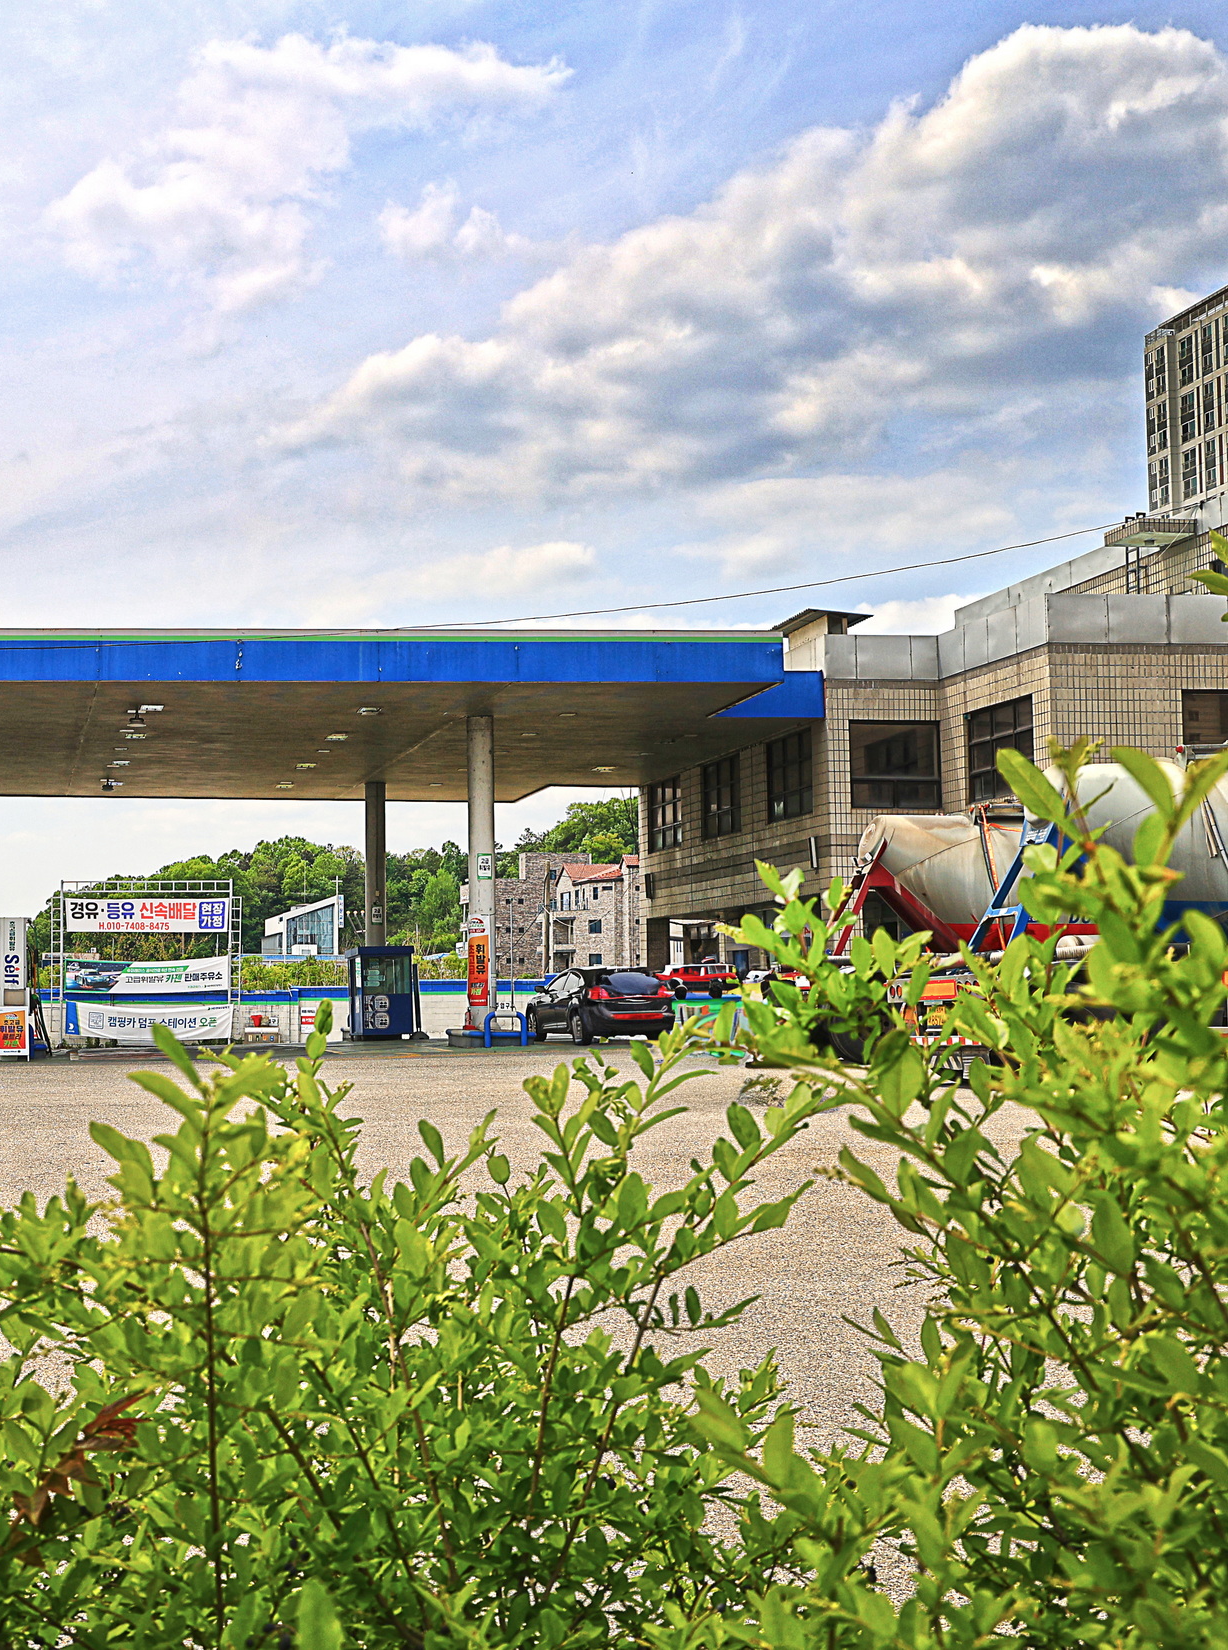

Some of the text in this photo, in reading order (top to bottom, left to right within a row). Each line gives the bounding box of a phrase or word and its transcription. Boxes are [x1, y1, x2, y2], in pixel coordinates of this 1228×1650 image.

[139, 902, 196, 920] 신속배달
[201, 903, 223, 915] 현장
[99, 922, 170, 930] H.010-7408-8475
[201, 916, 223, 928] 가정
[476, 944, 486, 974] 휘발유
[4, 954, 20, 985] Self
[165, 974, 182, 982] 카젠
[184, 972, 223, 982] 판매주유소
[108, 1016, 136, 1028] 캠핑카
[138, 1017, 156, 1028] 덤프
[160, 1016, 196, 1028] 스테이션
[199, 1017, 217, 1028] 오픈
